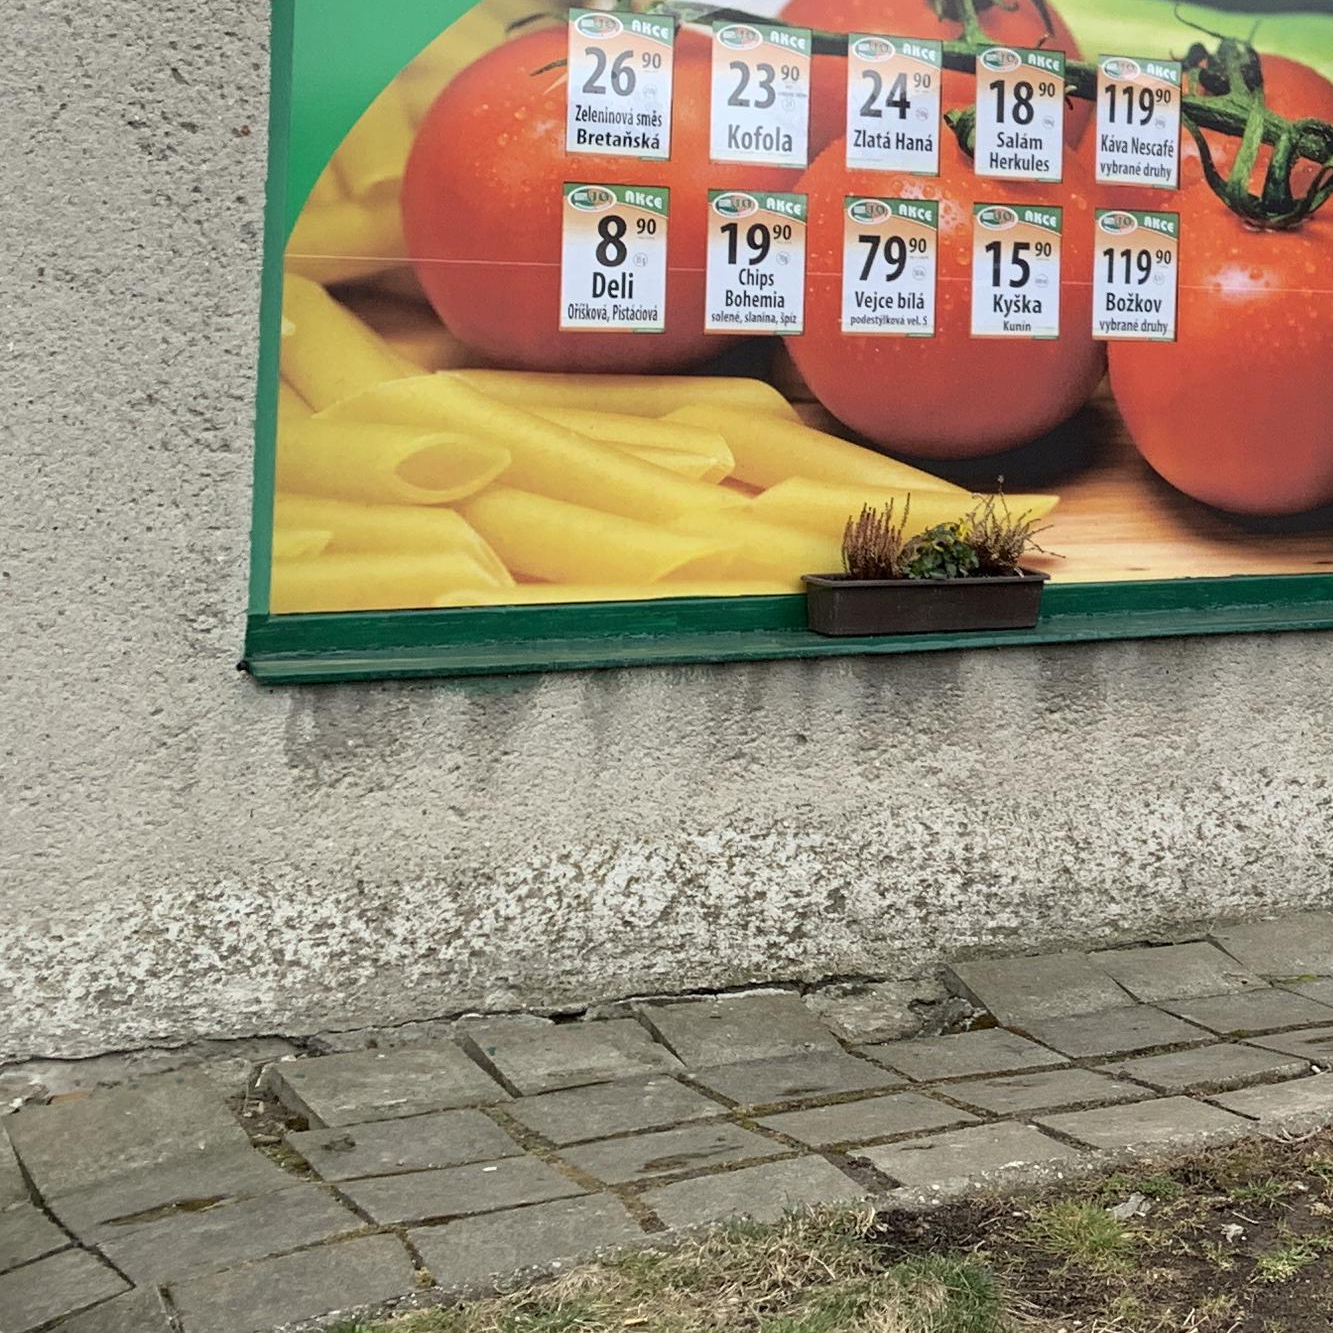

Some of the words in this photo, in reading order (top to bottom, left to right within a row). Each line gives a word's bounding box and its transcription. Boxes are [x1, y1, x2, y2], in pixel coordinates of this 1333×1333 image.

[632, 19, 669, 39] AKCE
[770, 30, 805, 49] AKCE
[902, 43, 936, 61] AKCE
[1028, 53, 1060, 71] AKCE
[582, 47, 636, 96] 26
[642, 52, 662, 69] 90
[1147, 63, 1177, 81] AKCE
[727, 60, 776, 109] 23
[781, 65, 800, 81] 90
[860, 70, 910, 119] 24
[914, 73, 931, 88] 90
[989, 80, 1034, 125] 18
[1039, 82, 1055, 97] 90
[1105, 84, 1154, 126] 119
[1155, 89, 1171, 103] 90
[575, 105, 634, 125] Zeleninová
[636, 110, 662, 127] směs
[577, 128, 660, 149] Bretaňská
[728, 124, 793, 152] Kofola
[853, 129, 891, 149] Zlatá
[896, 132, 933, 152] Haná
[997, 132, 1042, 150] Salám
[1101, 134, 1128, 154] Káva
[1131, 137, 1174, 158] Nescafé
[990, 152, 1049, 172] Herkules
[1100, 160, 1141, 177] vybrané
[1143, 163, 1172, 181] druhy
[625, 190, 663, 209] AKCE
[766, 198, 801, 215] AKCE
[898, 204, 932, 221] AKCE
[1025, 210, 1056, 227] AKCE
[1144, 216, 1174, 233] AKCE
[596, 215, 627, 267] 8
[636, 218, 656, 235] 90
[720, 222, 770, 266] 19
[773, 225, 791, 240] 90
[859, 234, 907, 282] 79
[909, 237, 927, 253] 90
[985, 241, 1030, 288] 15
[1035, 242, 1051, 257] 90
[1103, 248, 1151, 285] 119
[1156, 249, 1171, 264] 90
[592, 272, 634, 299] Deli
[739, 268, 774, 290] Chips
[725, 290, 785, 308] Bohemia
[855, 291, 893, 312] Vejce
[897, 292, 924, 309] bílá
[993, 294, 1042, 318] Kyška
[1105, 292, 1162, 313] Božkov
[567, 303, 609, 322] Oříšková,
[612, 304, 658, 321] Pistáciová
[1099, 317, 1138, 333] vybrané
[1141, 319, 1168, 335] druhy
